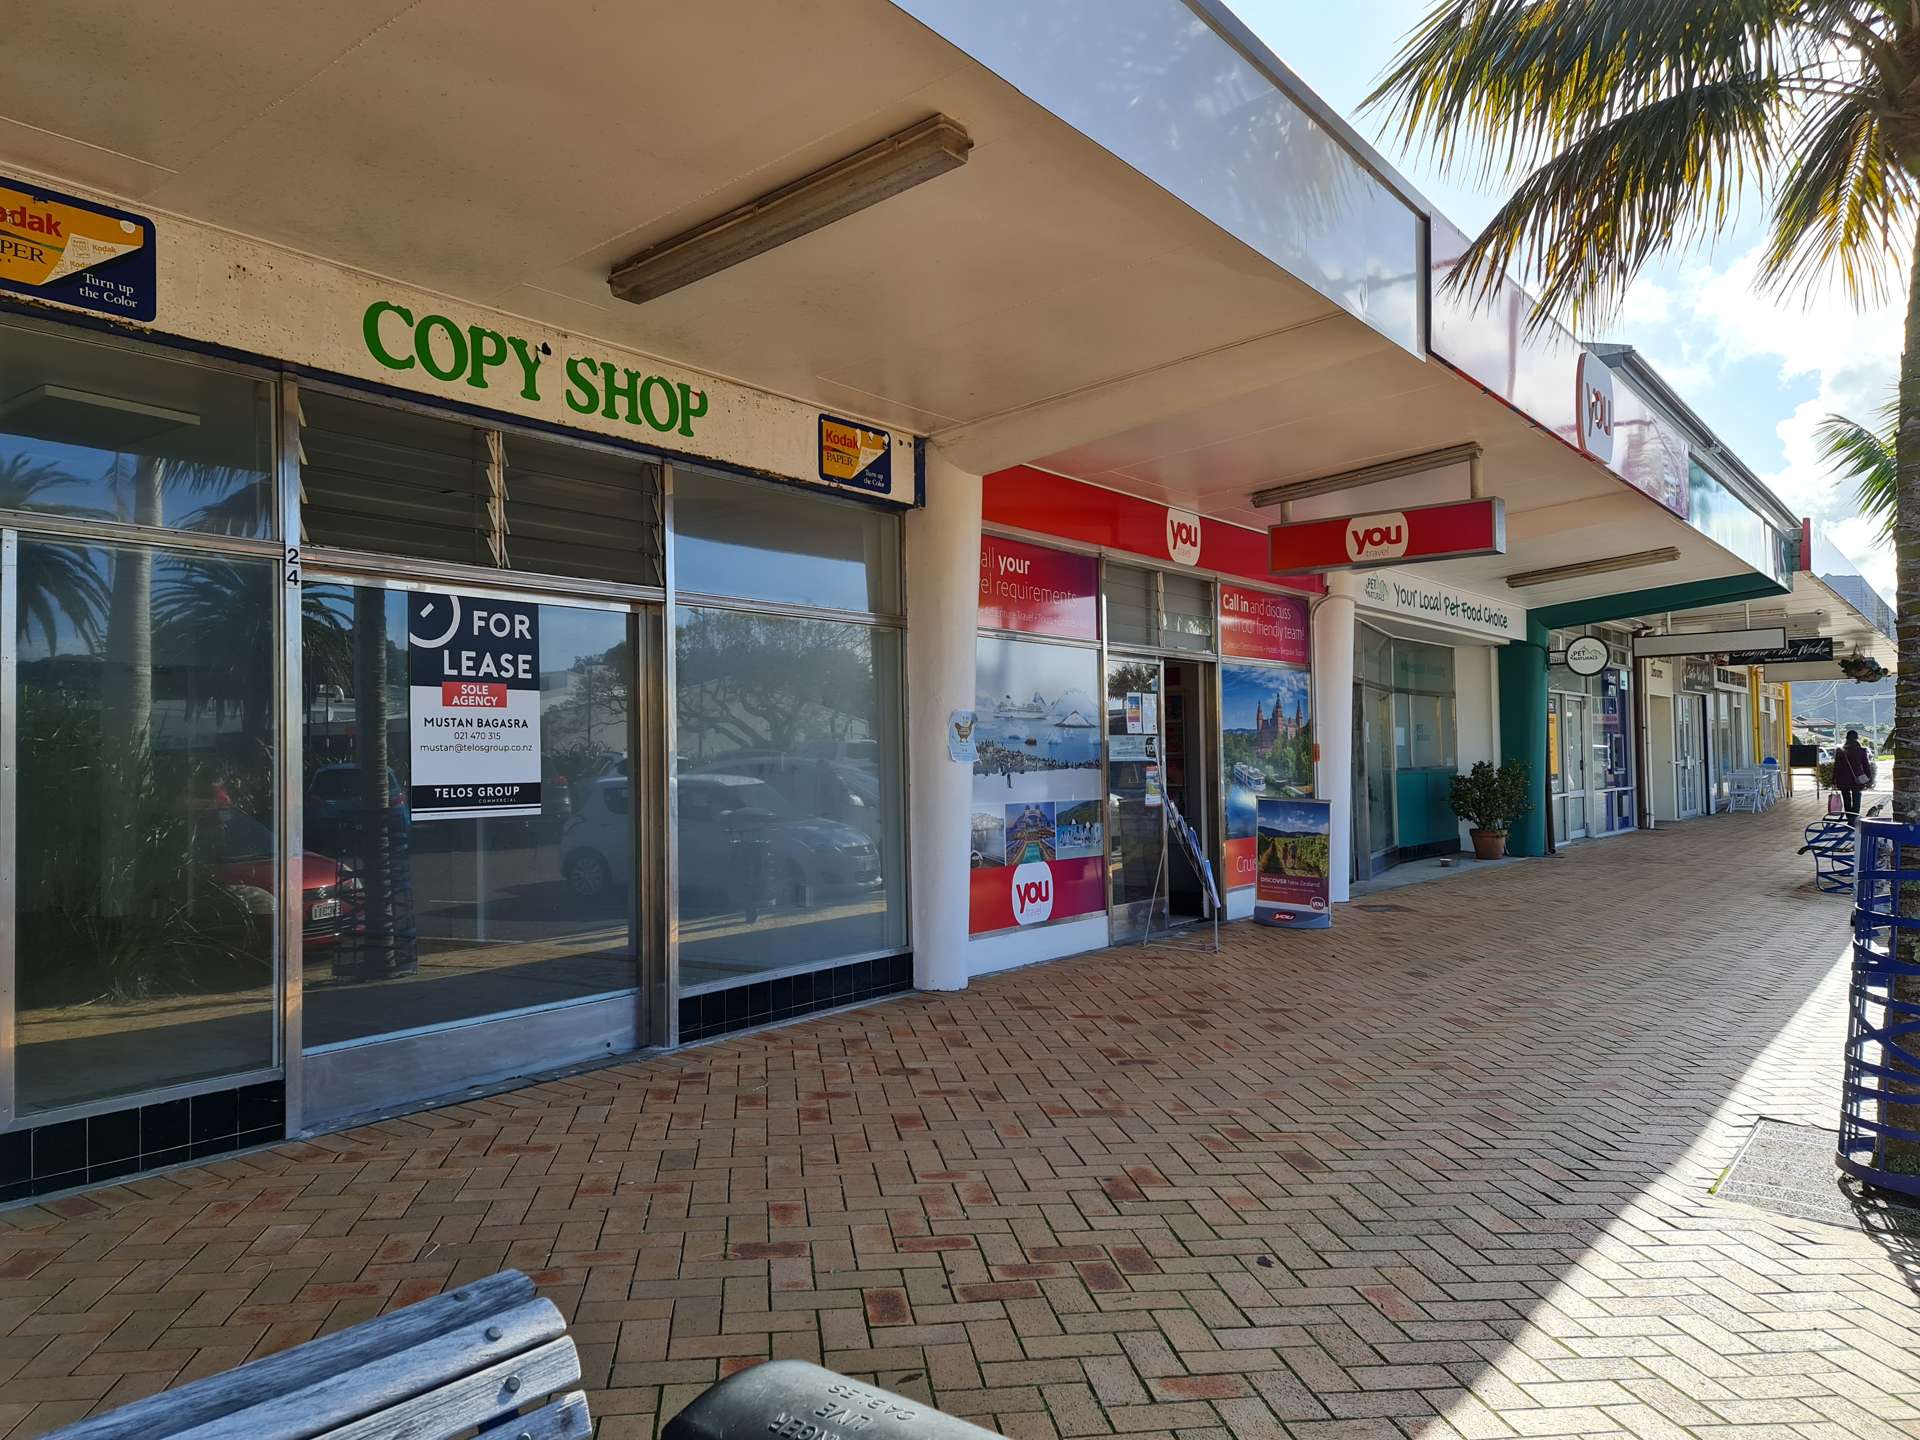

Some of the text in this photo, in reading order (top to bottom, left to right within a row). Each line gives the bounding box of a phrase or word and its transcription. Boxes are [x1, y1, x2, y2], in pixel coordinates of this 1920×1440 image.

[83, 272, 134, 297] Turn up
[80, 286, 138, 308] the Color
[363, 301, 708, 437] COPY SHOP
[1585, 382, 1611, 437] you
[825, 428, 860, 450] Kodak
[826, 452, 854, 466] PAPER
[1170, 520, 1197, 550] you
[1352, 525, 1402, 555] you
[998, 555, 1030, 575] your
[996, 580, 1077, 607] requirements
[1393, 583, 1508, 628] Your Local Pet Food Choice
[1223, 594, 1291, 620] Call in and discuss
[473, 610, 532, 640] FOR
[1256, 618, 1283, 641] friendly
[443, 650, 532, 679] LEASE
[452, 696, 498, 707] AGENCY
[461, 685, 488, 695] SOLE
[424, 717, 528, 729] MUSTAN BAGASRA
[420, 743, 533, 753] mustan@telosgroup.co.nz
[454, 732, 501, 740] 021 470 315
[434, 786, 520, 798] TELOS GROUP
[1016, 880, 1049, 914] you
